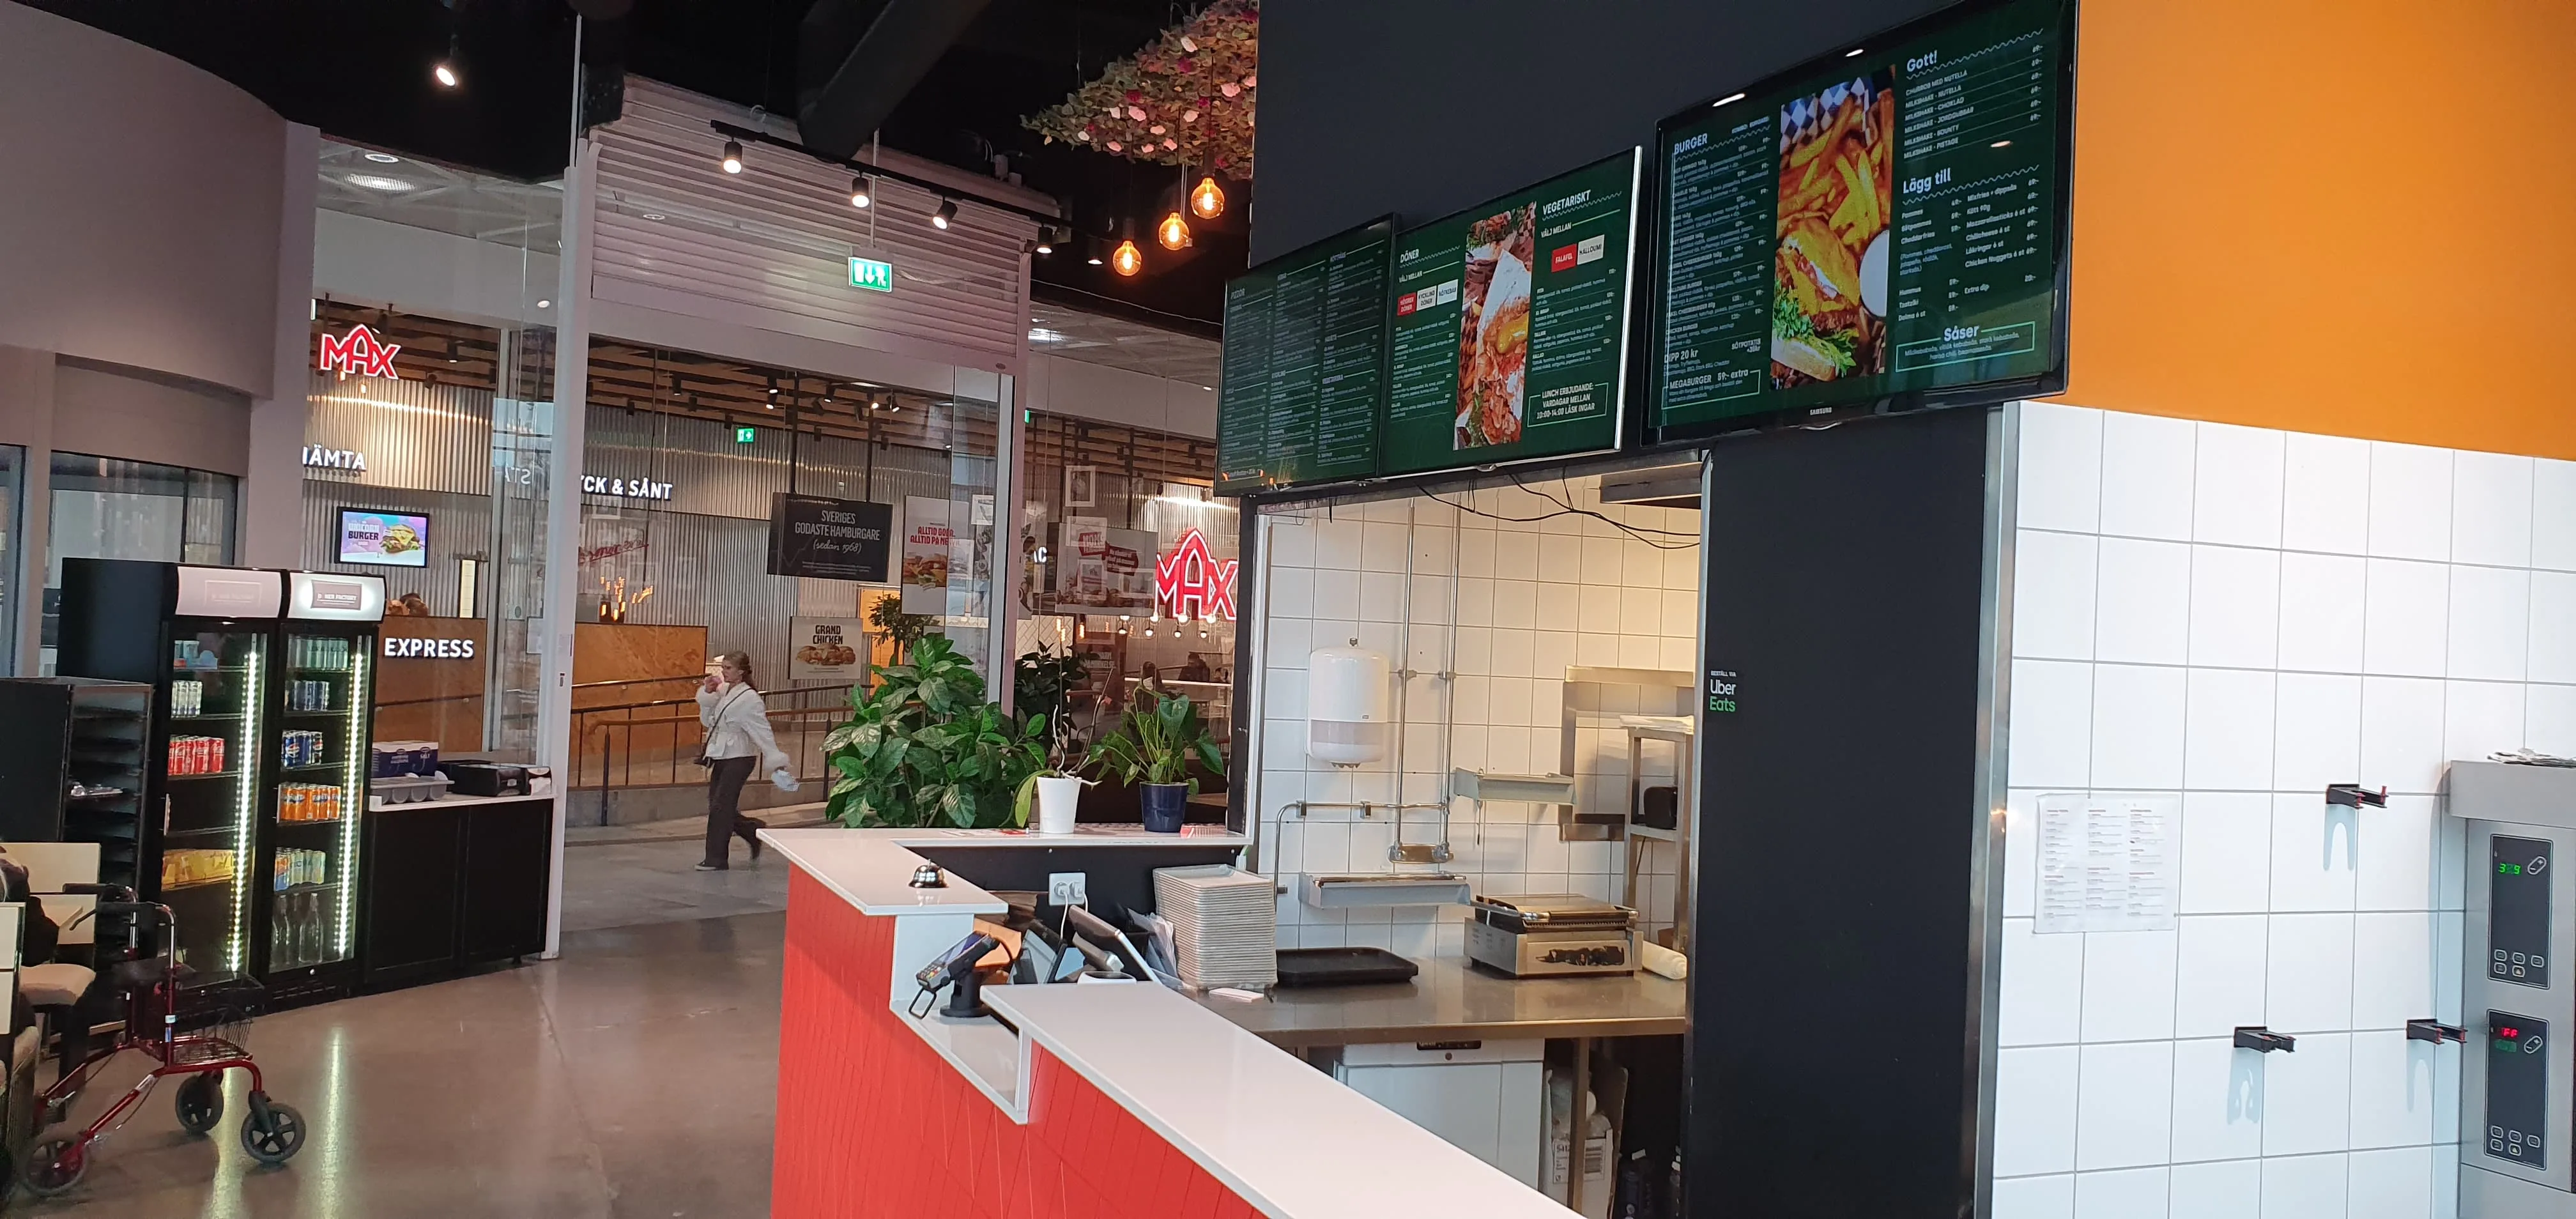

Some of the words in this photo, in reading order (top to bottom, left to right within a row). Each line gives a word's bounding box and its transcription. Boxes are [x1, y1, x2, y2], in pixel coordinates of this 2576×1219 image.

[1906, 50, 1937, 72] Gott!
[1674, 133, 1708, 155] BURGER
[1903, 176, 1931, 194] Lägg
[1935, 167, 1951, 185] till
[1543, 189, 1591, 215] VEGETARISKT
[1553, 222, 1572, 234] MELLAN
[1400, 249, 1419, 263] DÖNER
[1944, 325, 1979, 341] Såser
[320, 324, 401, 380] MAX
[1664, 352, 1679, 363] DIPP
[1680, 350, 1689, 360] 20
[1690, 349, 1698, 358] kr
[1670, 374, 1712, 389] MEGABURGER
[1731, 369, 1748, 379] extra
[1542, 388, 1559, 399] LUNCH
[1543, 397, 1569, 408] VARDAGAR
[1570, 394, 1590, 404] MELLAN
[1810, 407, 1832, 415] SAMSUNG
[581, 475, 608, 494] CK
[611, 479, 624, 495] &
[628, 477, 673, 500] SÅNT
[822, 510, 856, 525] SVERIGES
[348, 531, 379, 540] BURGER
[795, 522, 829, 537] GODASTE
[831, 525, 880, 541] HAMBURGARE
[917, 526, 937, 535] ALLTID
[813, 539, 839, 551] (sedan
[843, 542, 862, 555] 1968)
[910, 535, 930, 544] ALLTID
[1155, 528, 1239, 620] MAX
[815, 625, 841, 634] GRAND
[813, 635, 843, 644] CHICKEN
[385, 638, 474, 659] EXPRESS
[1710, 679, 1736, 695] Uber
[1710, 696, 1736, 712] Eats
